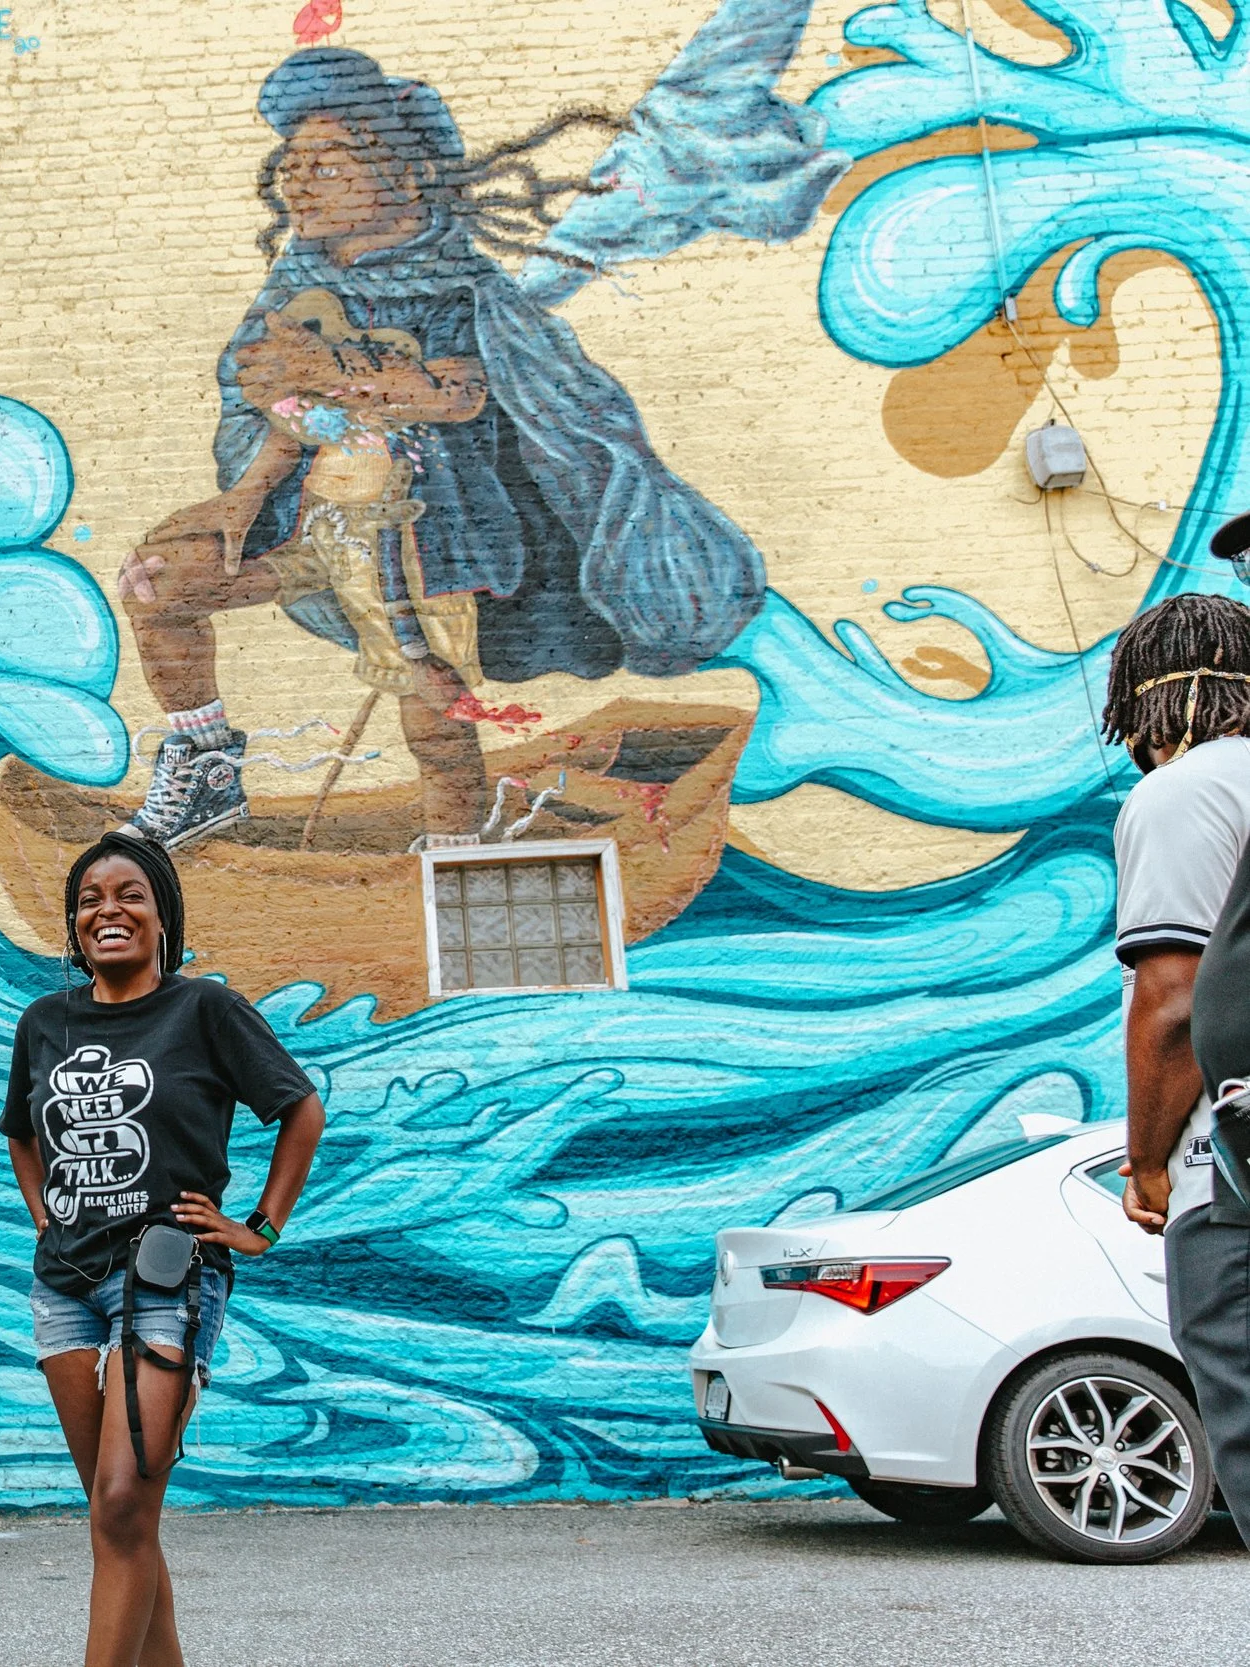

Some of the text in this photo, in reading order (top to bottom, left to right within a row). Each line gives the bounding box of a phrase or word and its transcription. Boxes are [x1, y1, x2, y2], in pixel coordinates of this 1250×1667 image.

[74, 1067, 126, 1094] WE
[57, 1095, 124, 1124] NEED
[77, 1130, 119, 1153] TO
[58, 1158, 133, 1187] TALK...
[84, 1190, 149, 1208] BLACK LIVES
[107, 1202, 148, 1217] MATTER
[783, 1247, 813, 1258] ILX
